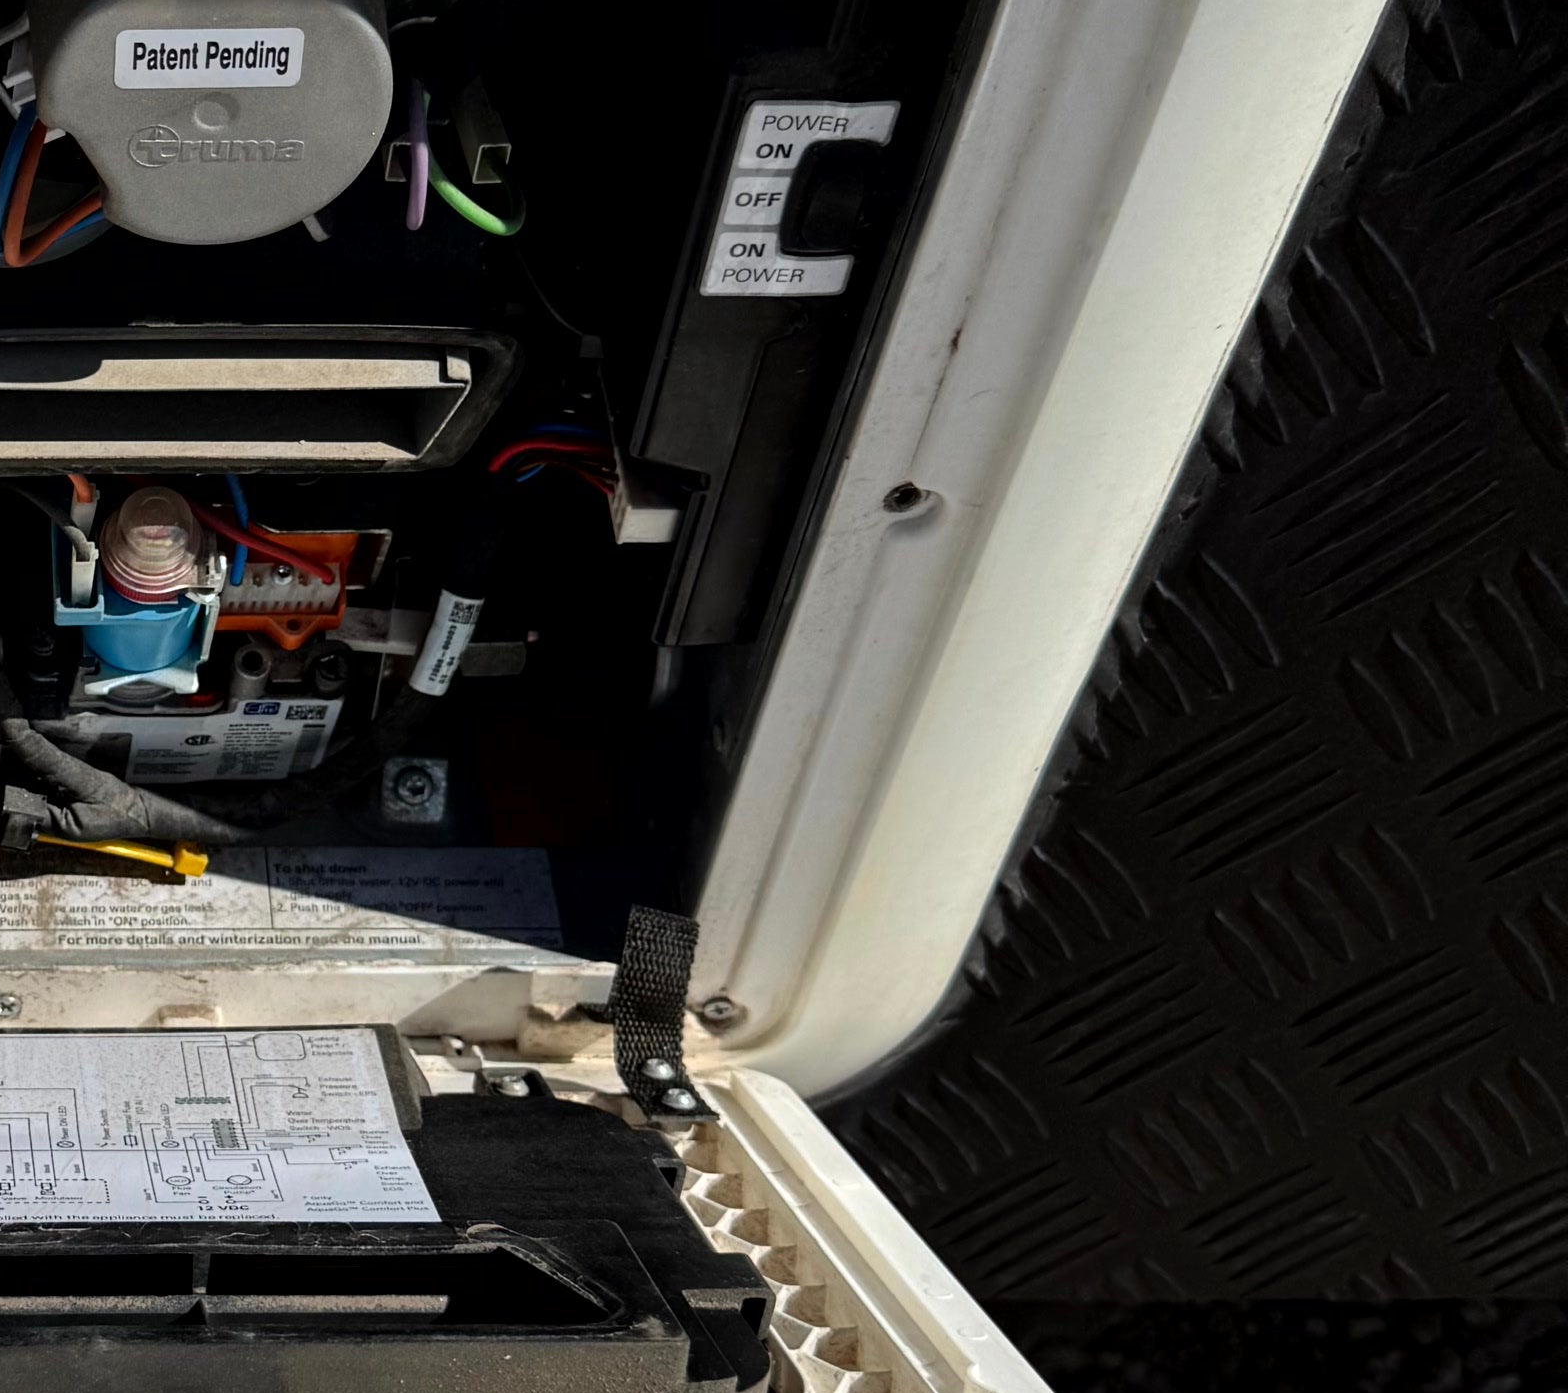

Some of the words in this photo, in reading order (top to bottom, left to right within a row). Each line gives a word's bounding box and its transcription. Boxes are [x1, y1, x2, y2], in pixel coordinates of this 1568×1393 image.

[133, 42, 198, 70] Patent
[205, 41, 290, 75] Pending
[761, 115, 849, 133] POWER
[755, 144, 793, 159] ON
[735, 192, 782, 207] OFF
[729, 243, 765, 257] ON
[721, 268, 805, 283] POWER
[58, 933, 82, 945] For
[85, 935, 123, 945] more
[127, 933, 174, 945] details
[178, 934, 206, 945] and
[209, 933, 303, 945] winterization
[369, 934, 425, 944] manual.
